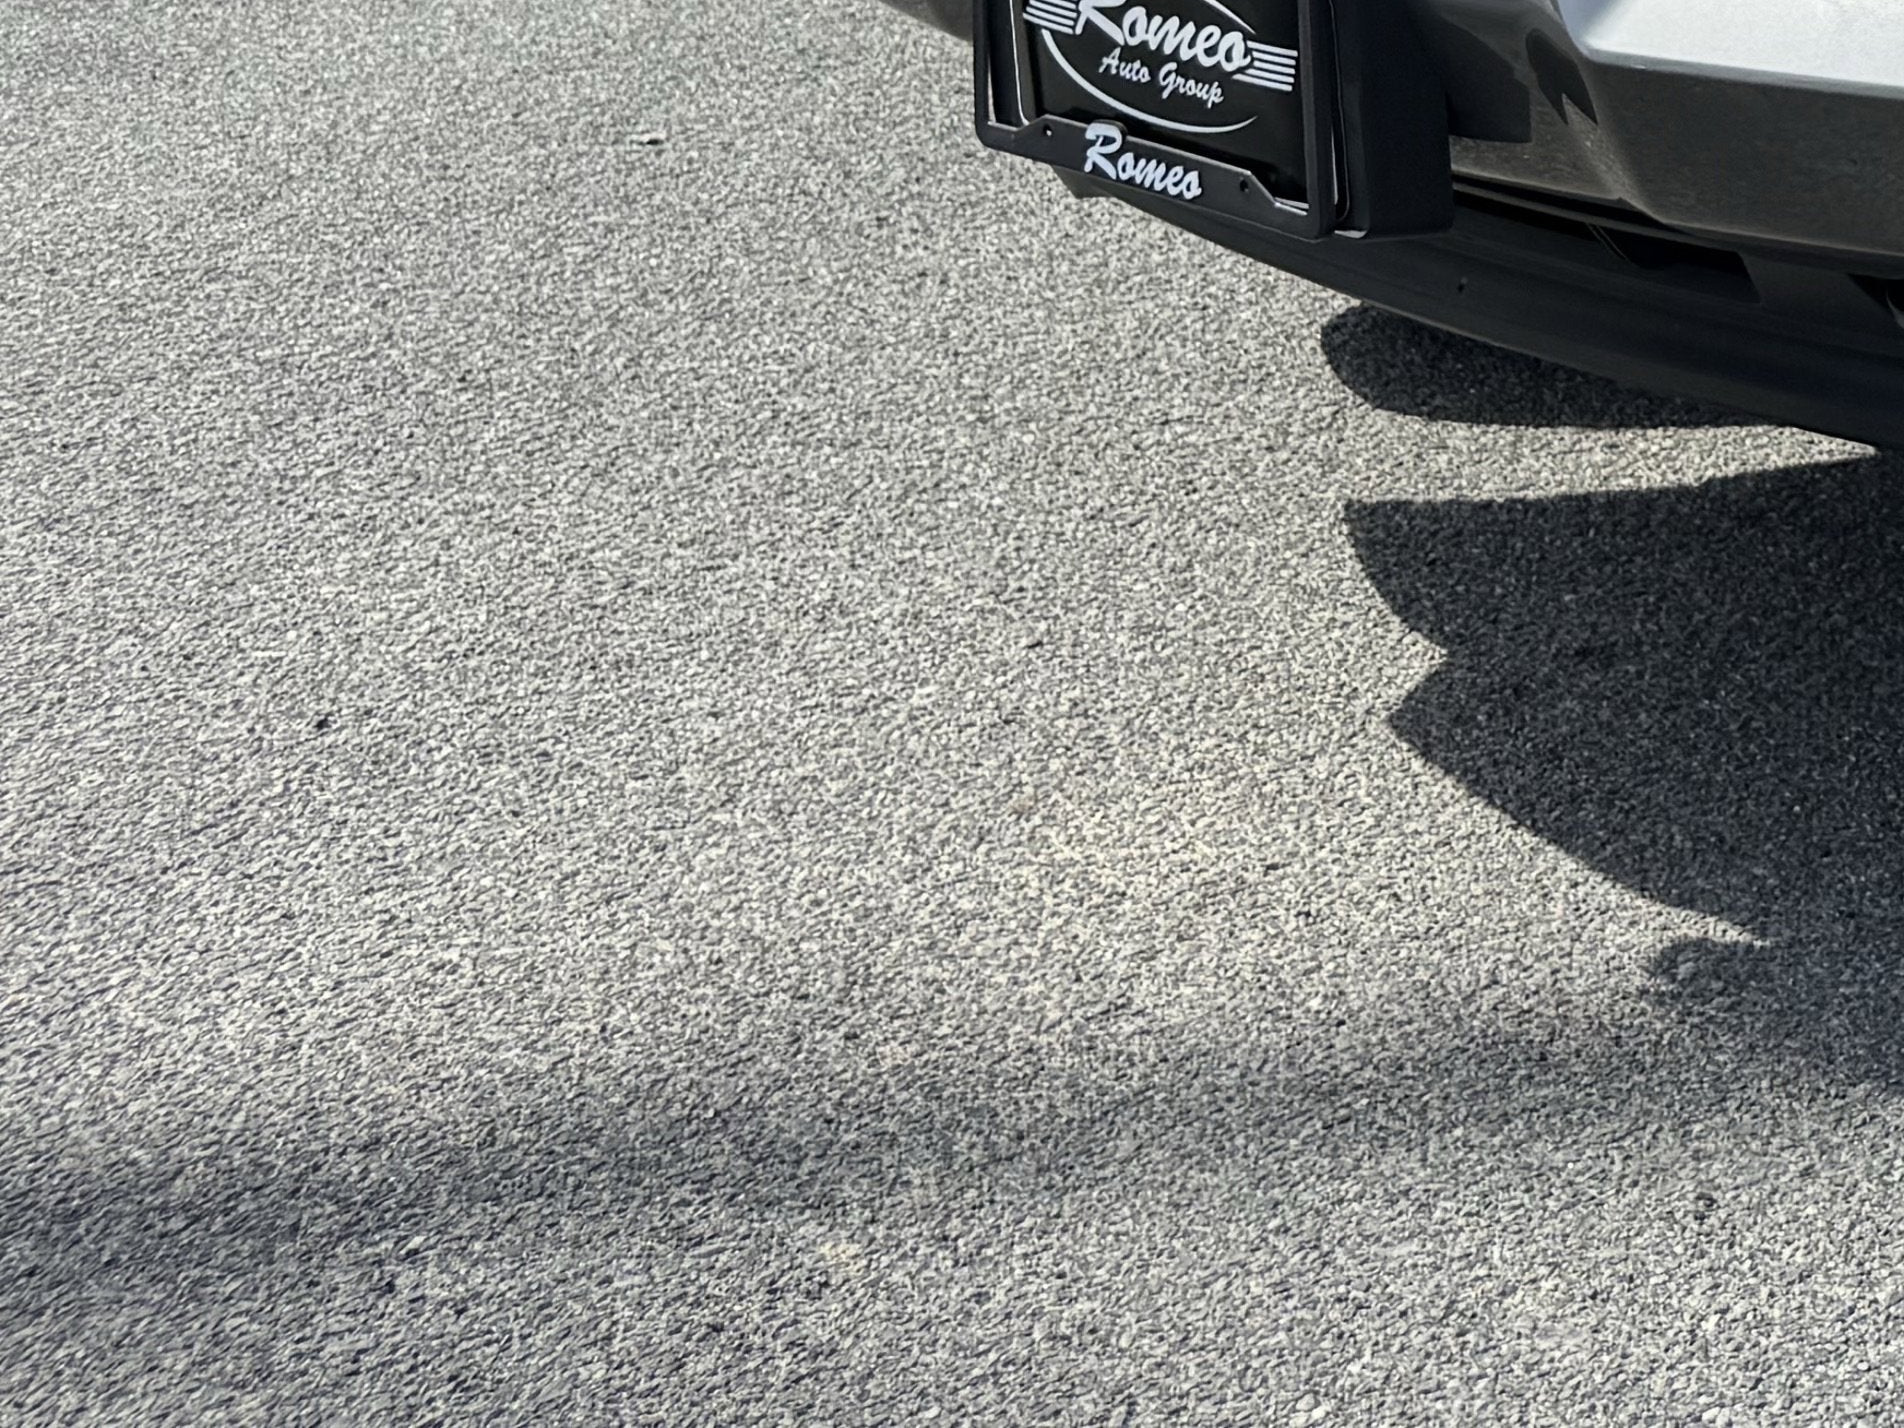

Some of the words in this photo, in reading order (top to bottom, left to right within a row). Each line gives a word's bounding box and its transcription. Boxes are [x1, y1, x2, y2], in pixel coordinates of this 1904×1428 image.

[1098, 47, 1152, 85] Auto
[1158, 63, 1225, 108] Group
[1083, 122, 1202, 200] Romeo
